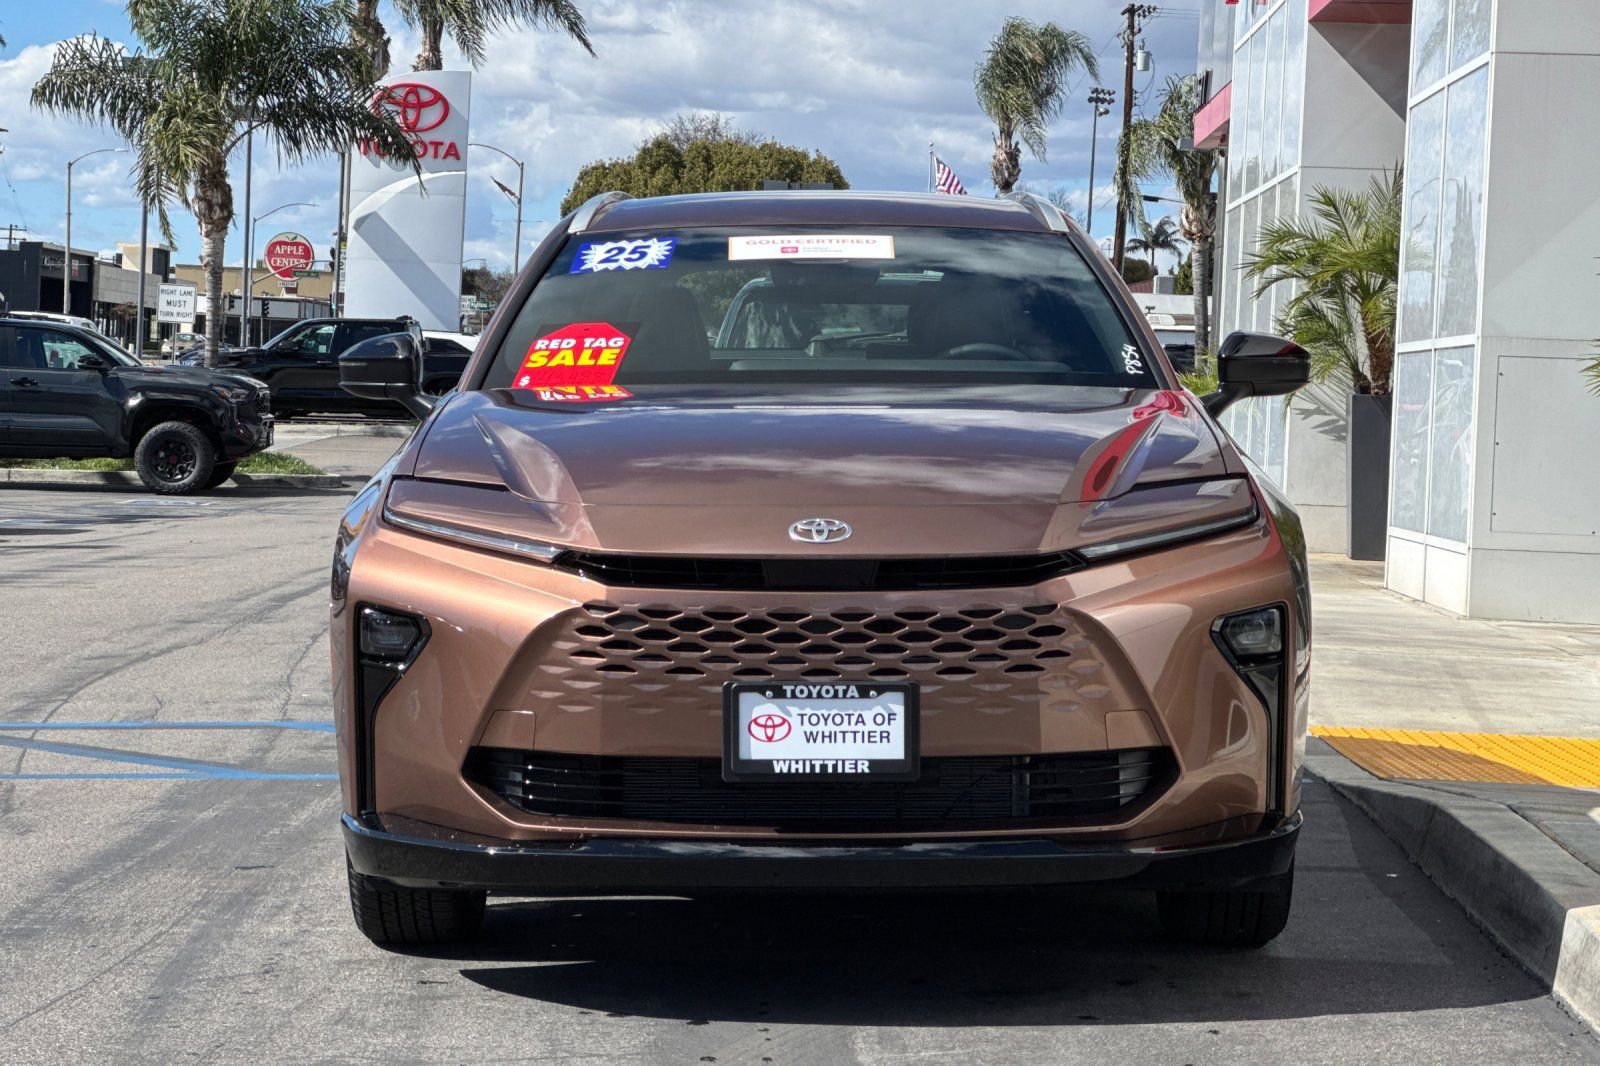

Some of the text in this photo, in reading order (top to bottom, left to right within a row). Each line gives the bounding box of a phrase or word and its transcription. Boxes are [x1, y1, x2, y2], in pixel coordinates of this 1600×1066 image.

[274, 245, 304, 255] APPLE
[597, 244, 652, 264] 25
[271, 257, 306, 267] CENTER
[160, 288, 194, 297] RIGHT LANE
[166, 299, 187, 308] MUST
[176, 311, 193, 319] RIGHT
[534, 337, 625, 350] RED TAG
[525, 348, 621, 368] SALE
[1121, 343, 1144, 375] P854
[782, 685, 860, 699] TOYOTA
[797, 713, 897, 727] TOYOTA OF
[803, 730, 891, 744] WHITTIER
[772, 759, 870, 774] WHITTIER
